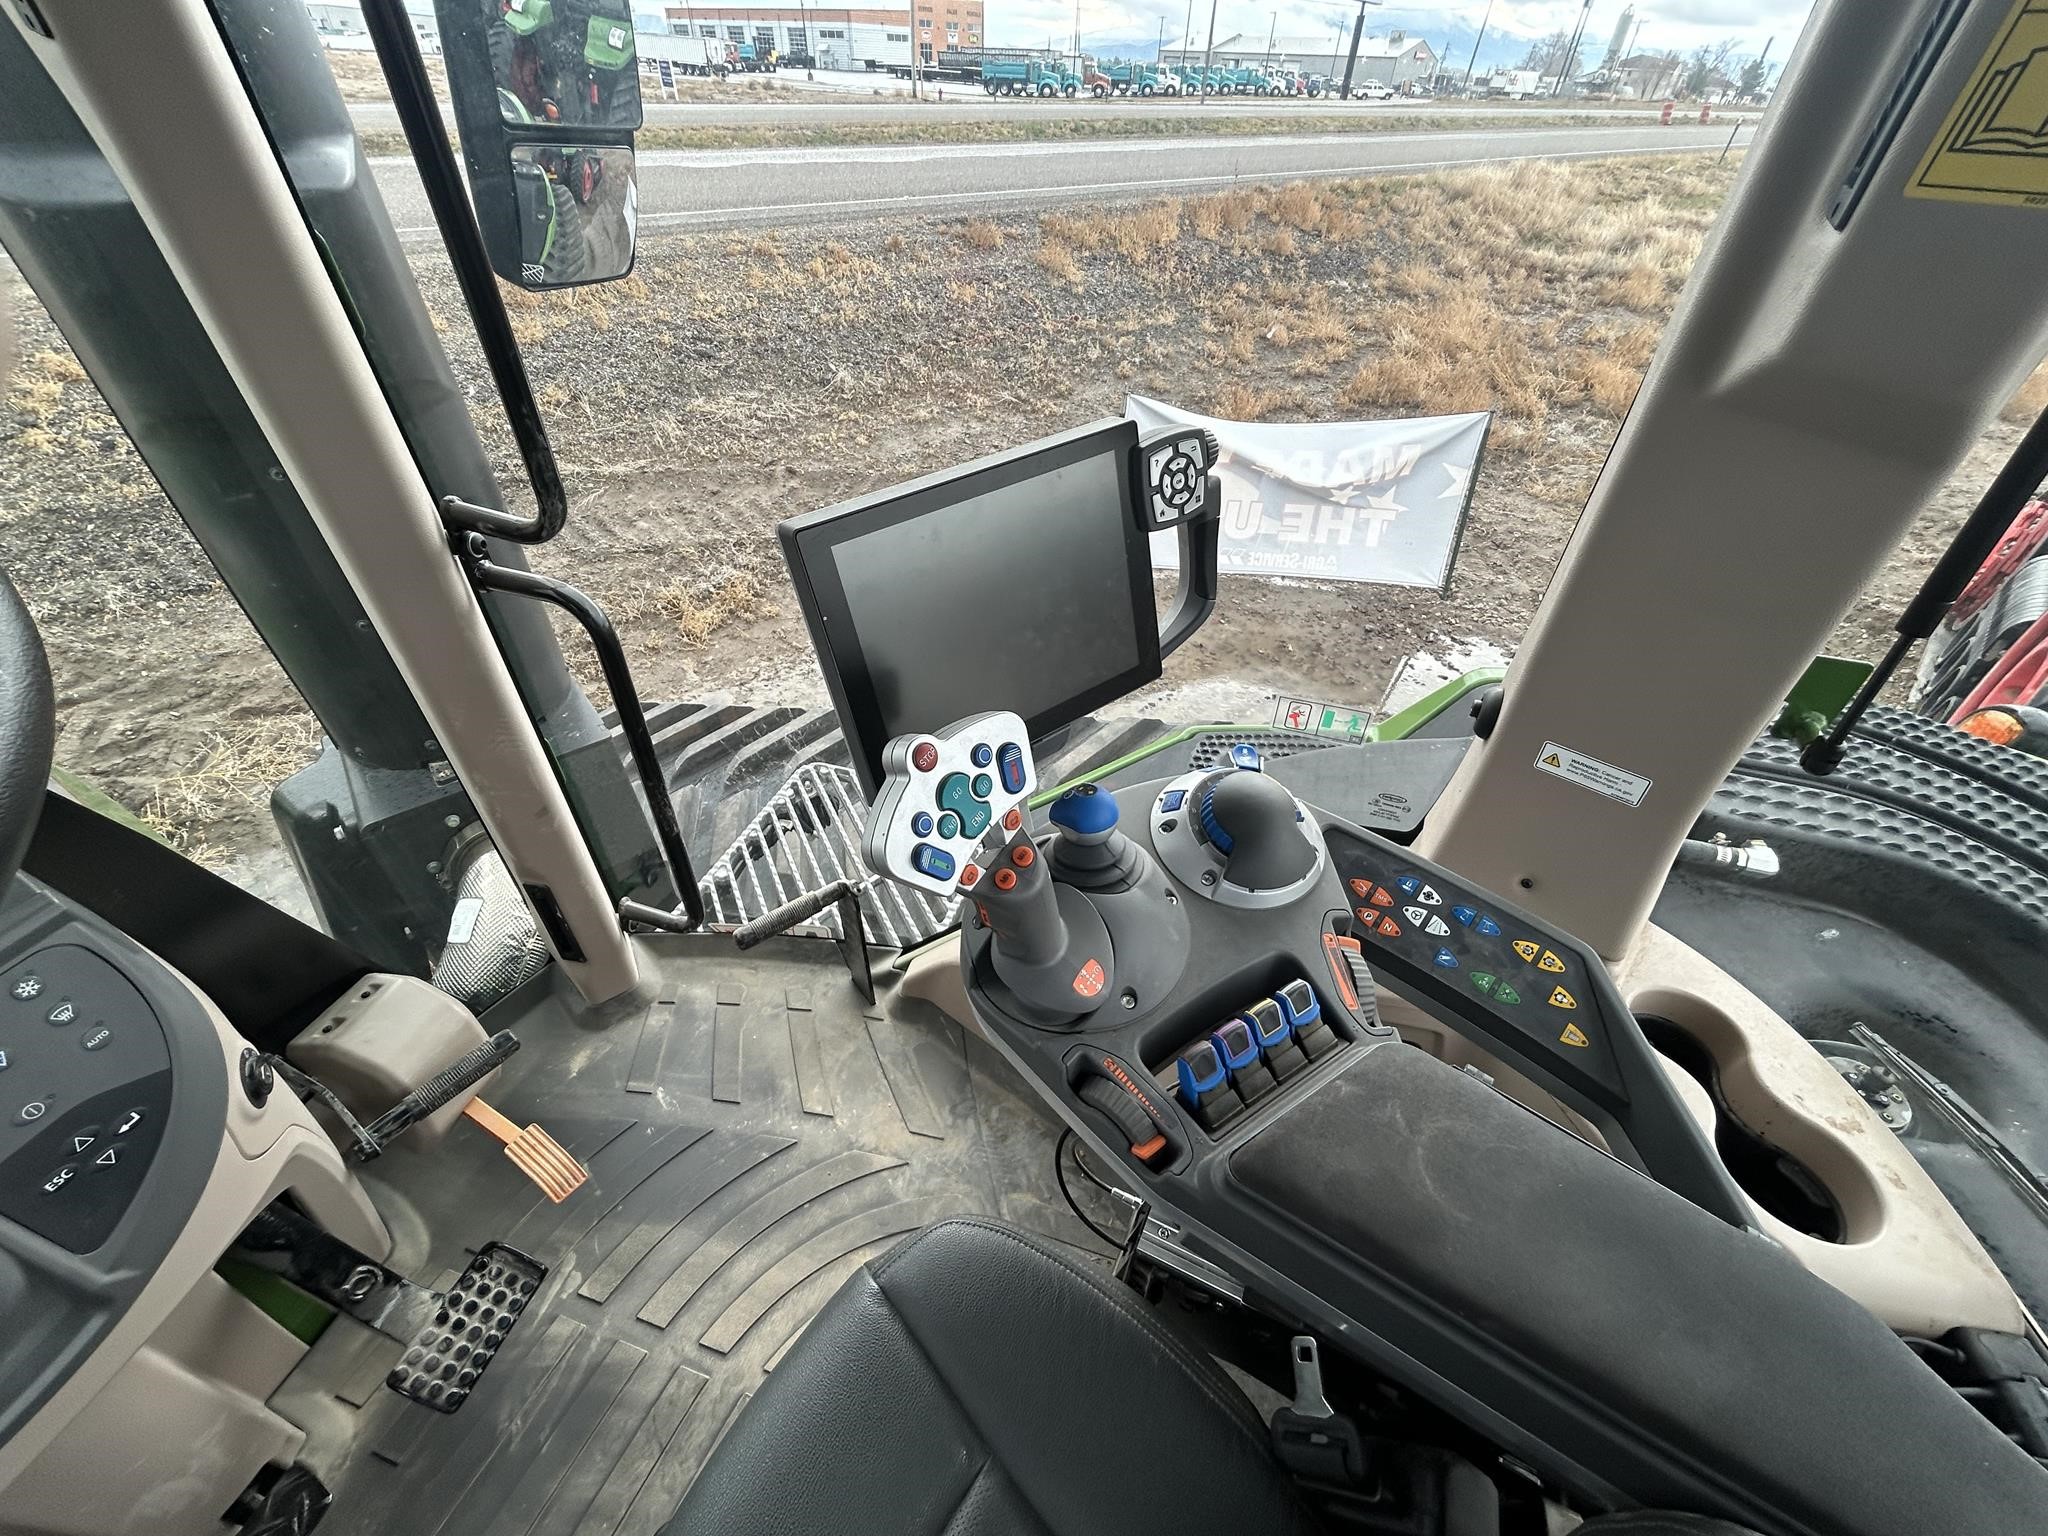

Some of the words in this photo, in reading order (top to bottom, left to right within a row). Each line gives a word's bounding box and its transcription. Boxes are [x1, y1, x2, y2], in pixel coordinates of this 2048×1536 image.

[919, 746, 938, 768] STOP
[952, 787, 963, 800] GO
[979, 780, 991, 792] GO
[943, 817, 959, 836] END
[972, 810, 986, 828] END
[1383, 922, 1393, 932] N
[86, 1029, 111, 1049] AUTO
[43, 1167, 75, 1193] ESC
